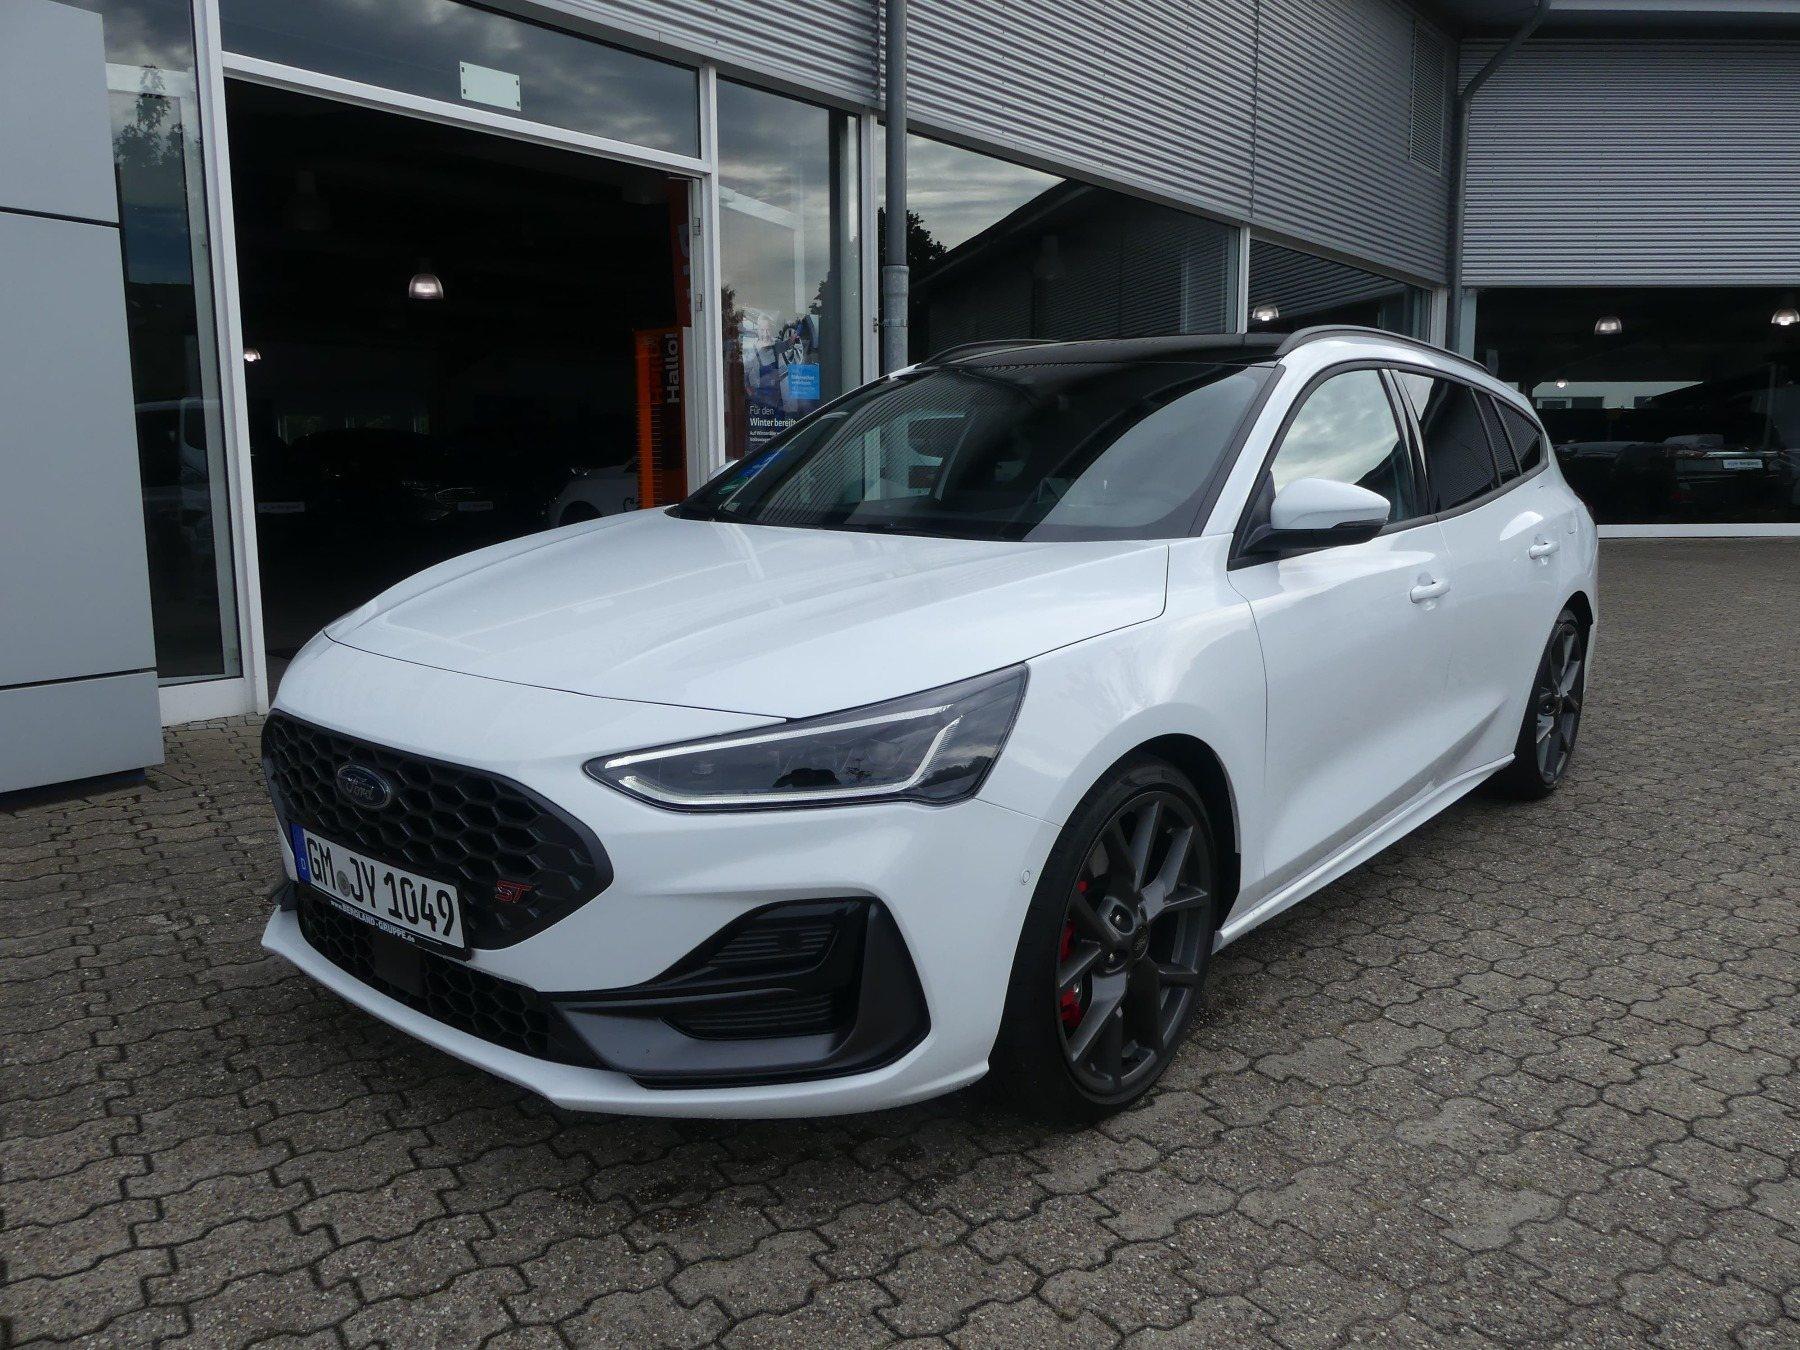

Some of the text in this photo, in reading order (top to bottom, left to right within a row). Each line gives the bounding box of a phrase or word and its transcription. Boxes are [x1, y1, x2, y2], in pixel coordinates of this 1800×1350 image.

[749, 405, 774, 415] Für den
[750, 418, 774, 427] Winter
[306, 837, 455, 936] GM JY 1049
[494, 879, 534, 903] ST
